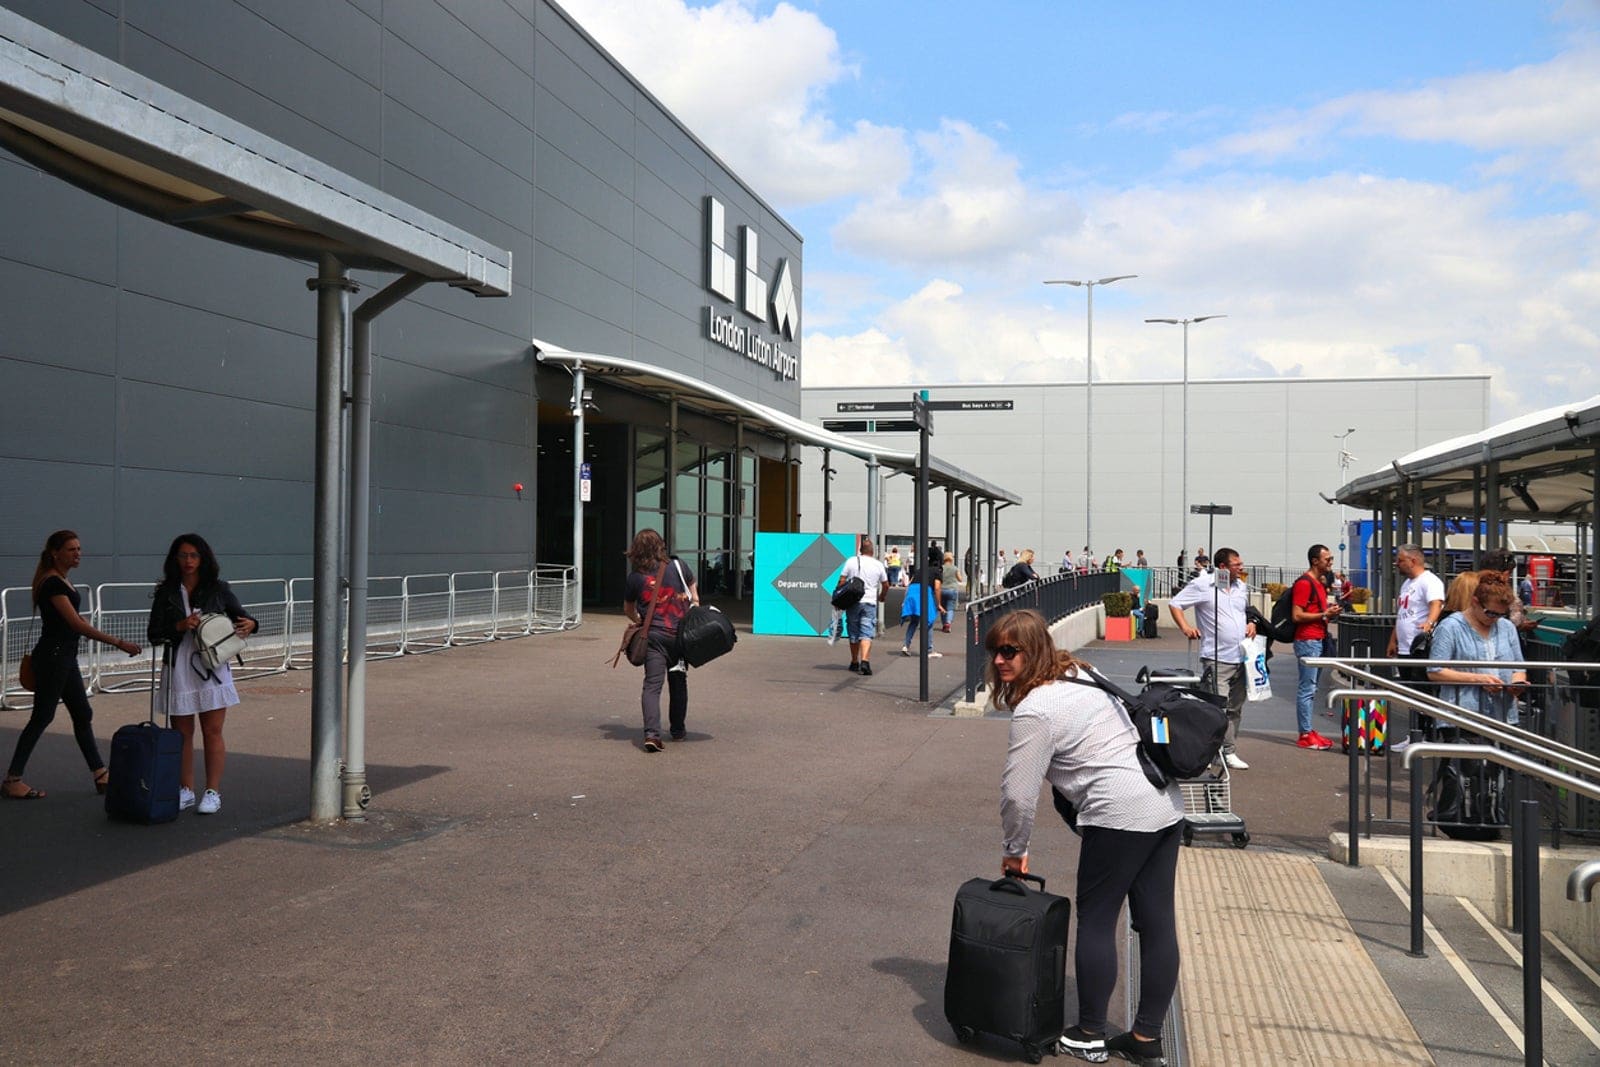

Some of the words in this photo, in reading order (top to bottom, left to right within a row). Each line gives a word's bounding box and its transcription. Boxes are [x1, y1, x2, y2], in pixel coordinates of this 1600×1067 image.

[710, 305, 745, 354] London
[747, 326, 772, 368] Luton
[773, 342, 798, 382] Airport
[777, 580, 818, 589] Departures
